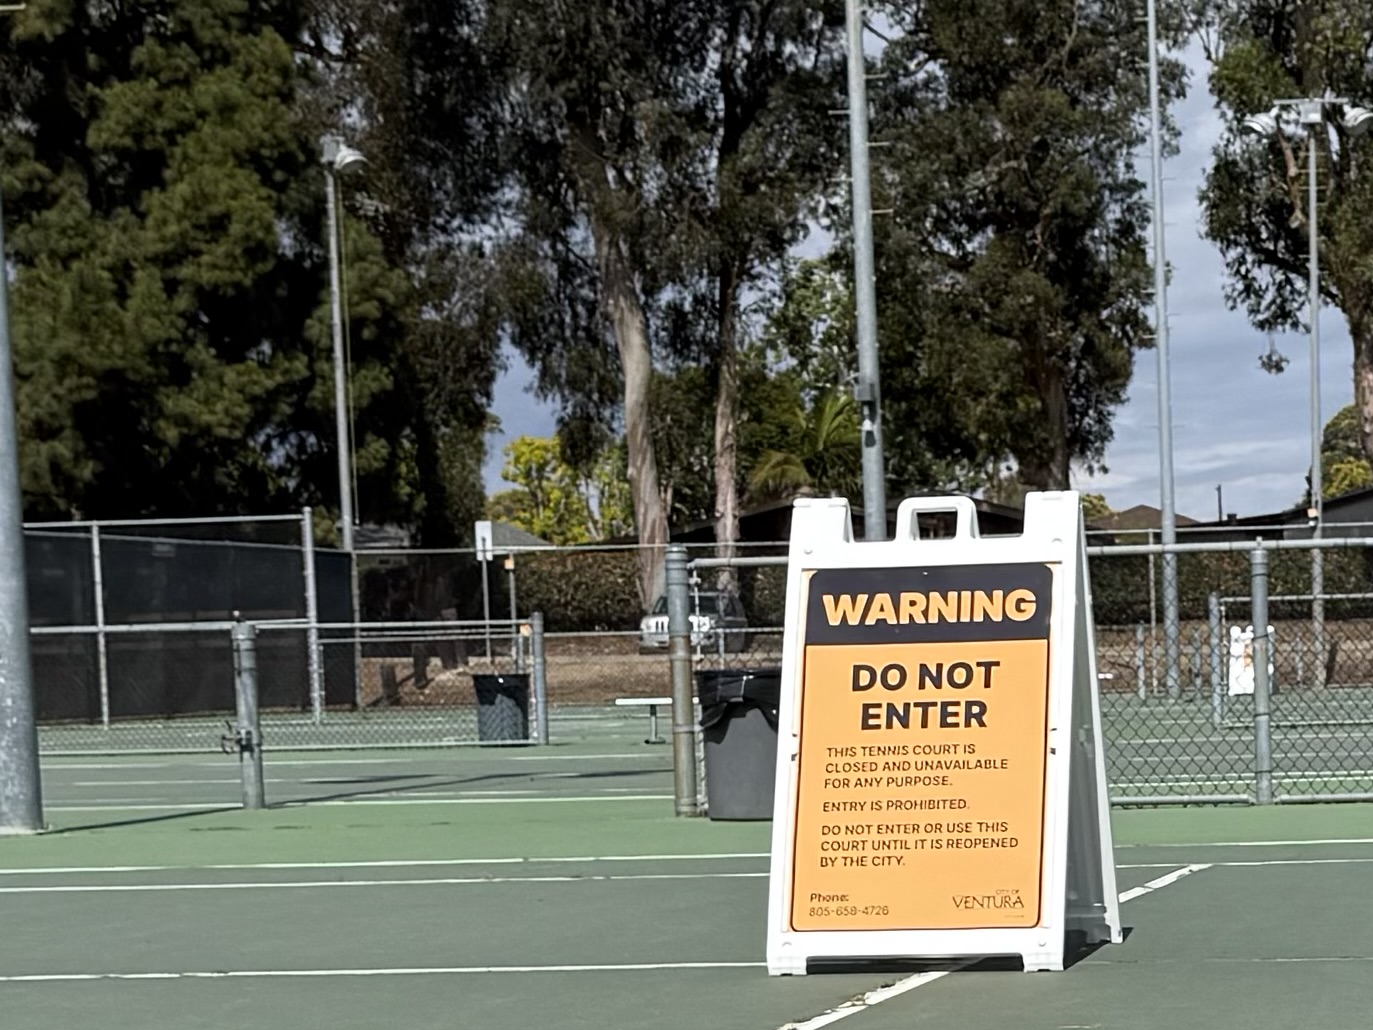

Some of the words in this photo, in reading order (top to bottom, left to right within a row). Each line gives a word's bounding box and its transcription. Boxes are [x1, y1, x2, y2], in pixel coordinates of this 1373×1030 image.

[823, 589, 1036, 626] WARNING
[852, 664, 907, 692] DO
[918, 661, 1000, 690] NOT
[861, 701, 987, 730] ENTER
[827, 747, 856, 757] THIS
[861, 745, 909, 756] TENNIS
[913, 744, 960, 755] COURT
[964, 744, 975, 754] IS
[826, 762, 878, 773] CLOSED
[883, 761, 911, 771] AND
[915, 759, 1008, 771] UNAVAILABLE
[825, 778, 850, 789] FOR
[854, 777, 883, 788] ANY
[887, 776, 952, 787] PURPOSE.
[823, 801, 867, 812] ENTRY
[871, 800, 882, 811] IS
[887, 799, 969, 810] PROHIBITED.
[822, 825, 841, 835] DO
[845, 825, 873, 835] NOT
[877, 824, 920, 834] ENTER
[924, 823, 942, 833] OR
[947, 822, 972, 833] USE
[977, 822, 1008, 832] THIS
[821, 840, 868, 851] COURT
[872, 840, 911, 851] UNTIL
[915, 839, 927, 849] IT
[931, 839, 942, 849] IS
[947, 838, 1018, 849] REOPENED
[820, 857, 837, 867] BY
[841, 856, 867, 866] THE
[872, 856, 905, 866] CITY.
[810, 892, 849, 902] Phone:
[952, 895, 1024, 909] VENTURA
